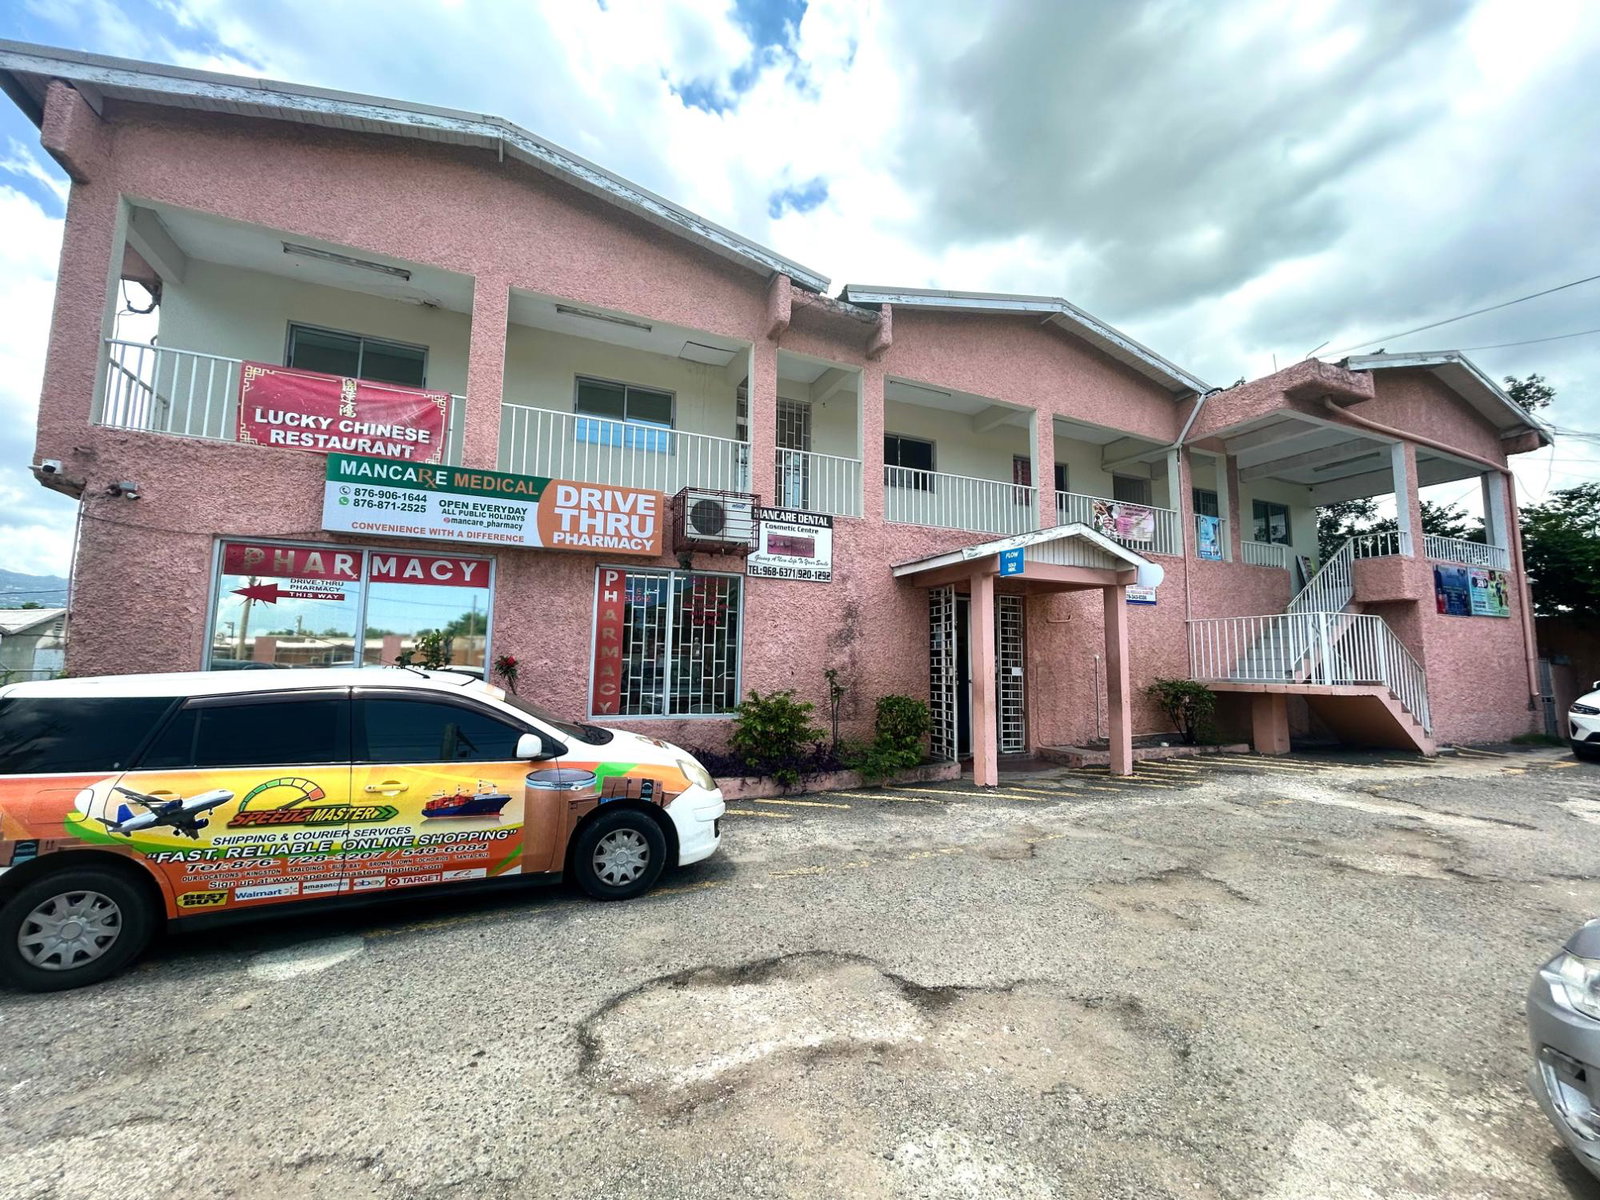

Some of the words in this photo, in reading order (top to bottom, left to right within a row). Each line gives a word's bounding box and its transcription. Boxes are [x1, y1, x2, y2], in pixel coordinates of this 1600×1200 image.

[255, 408, 334, 430] LUCKY
[338, 420, 430, 444] CHINESE
[270, 429, 415, 459] RESTAURANT
[454, 472, 539, 496] MEDICAL
[354, 488, 428, 503] 876-906-1644
[556, 484, 656, 516] DRIVE
[353, 498, 427, 513] 876-871-2525
[438, 500, 469, 510] OPEN
[472, 503, 528, 516] EVERYDAY
[441, 508, 456, 516] ALL
[458, 510, 487, 518] PUBLIC
[488, 512, 526, 522] HOLIDAYS
[798, 514, 828, 526] DENTAL
[450, 518, 523, 531] mancare_pharmacy
[554, 507, 654, 539] THRU
[765, 522, 796, 532] Cosmetic
[797, 526, 819, 534] Centre
[352, 522, 426, 534] CONVENIENCE
[429, 528, 454, 538] WITH
[457, 530, 464, 538] A
[466, 531, 524, 542] DIFFERENCE
[553, 532, 654, 551] PHARMACY
[290, 578, 344, 587] DRIVE-THRU
[318, 592, 340, 600] WAY
[598, 570, 618, 714] PHARMACY
[212, 834, 277, 846] SHIPPING
[280, 833, 290, 841] &
[293, 830, 350, 840] COURIER
[354, 826, 412, 837] SERVICES
[225, 840, 334, 858] RELIABLE
[342, 836, 416, 850] ONLINE
[388, 849, 398, 858] /
[402, 843, 488, 856] 548-6084
[199, 872, 240, 880] LOCATIONS
[209, 880, 236, 889] Sign
[235, 888, 282, 900] Walmart
[302, 881, 349, 890] amazon.com
[354, 878, 385, 888] ebay
[402, 874, 440, 884] TARGET
[183, 892, 228, 900] BEST
